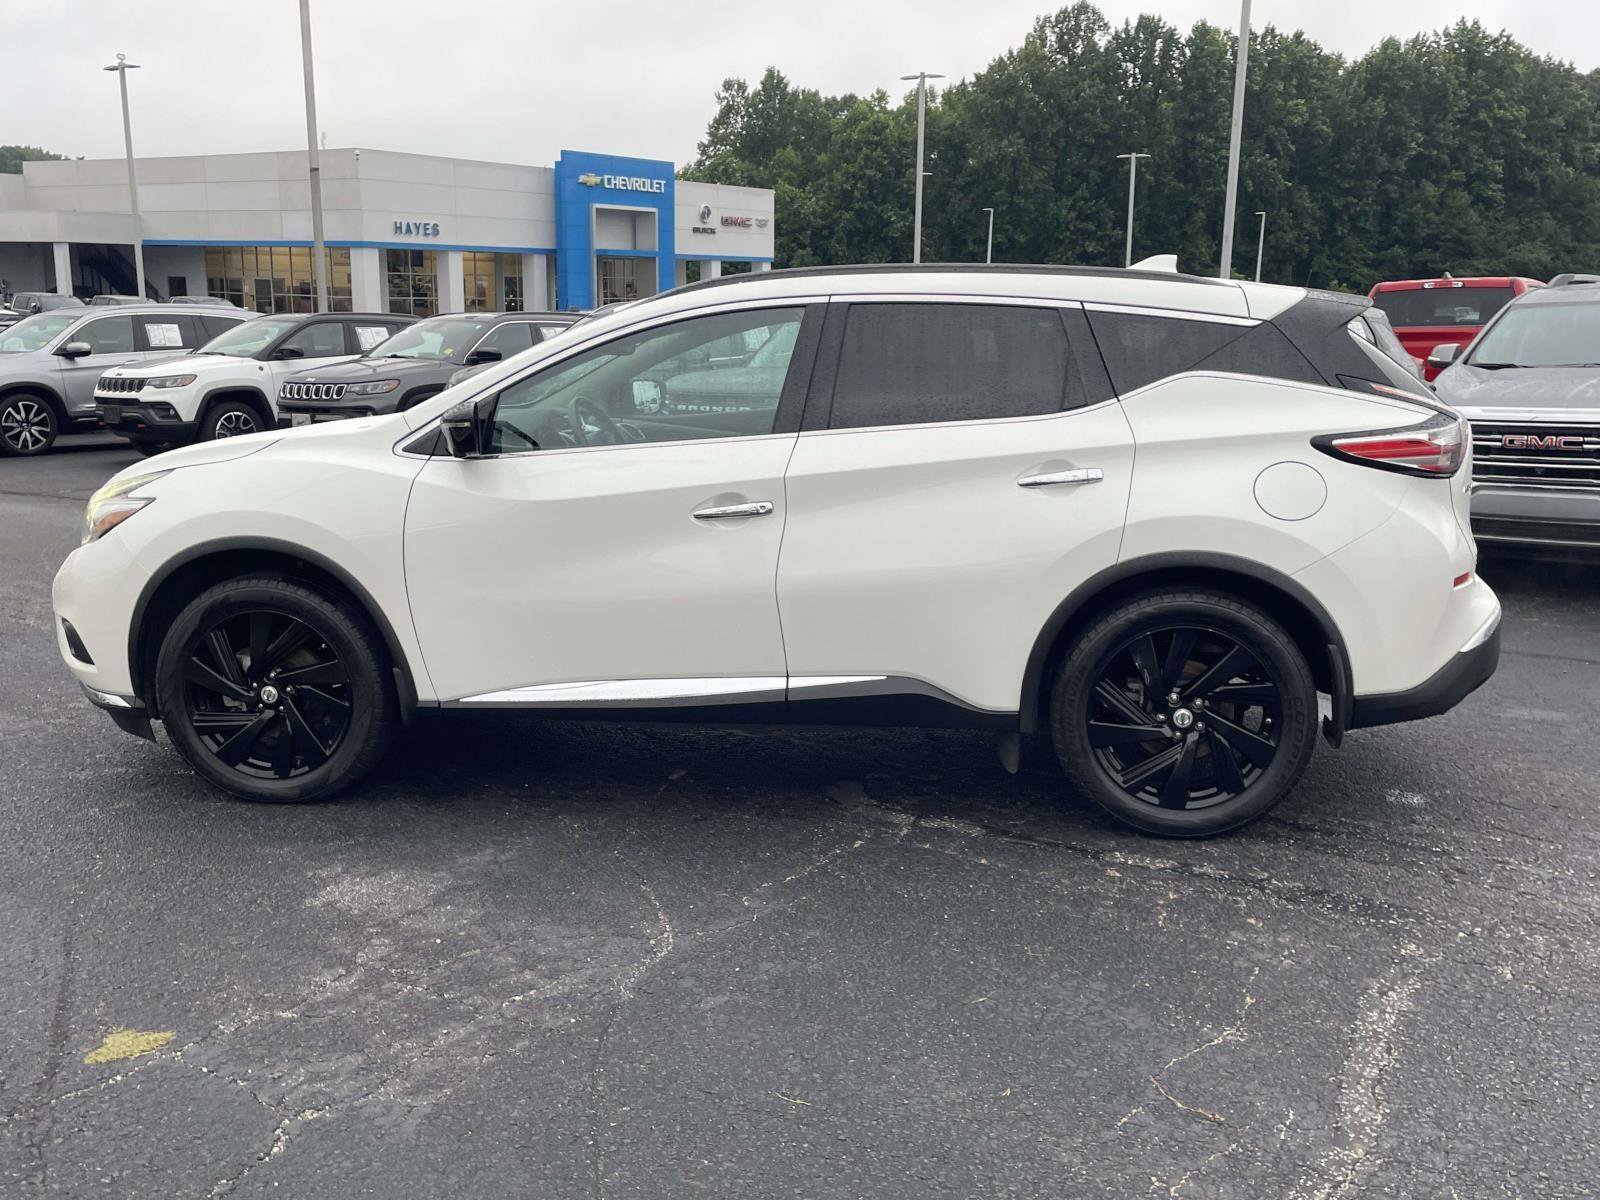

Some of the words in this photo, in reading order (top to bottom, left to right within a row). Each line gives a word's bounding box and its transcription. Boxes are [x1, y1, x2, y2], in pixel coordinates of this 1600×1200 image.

[603, 174, 667, 194] CHEVROLET
[393, 220, 440, 238] HAYES
[1502, 434, 1584, 451] GMC
